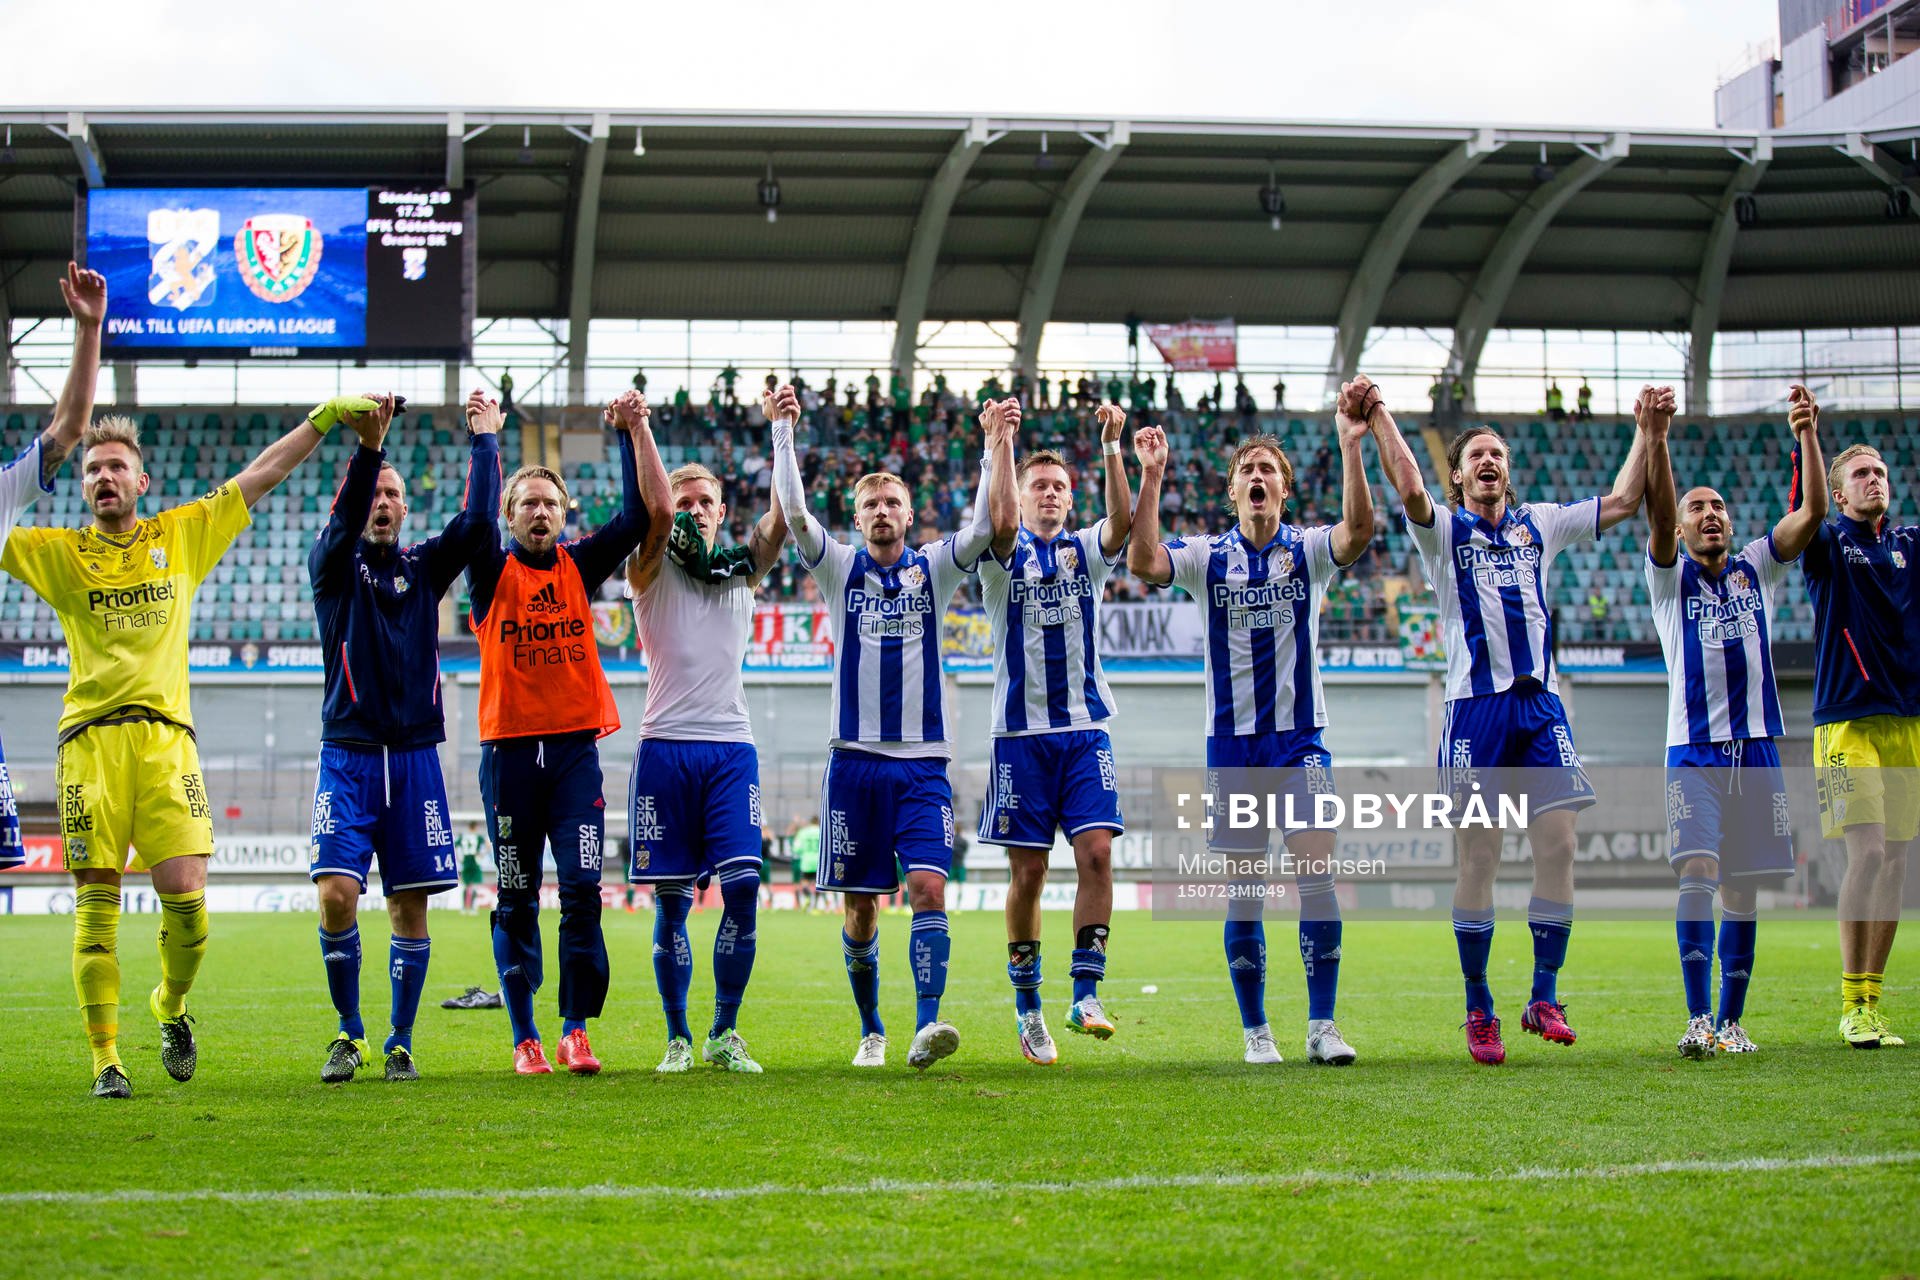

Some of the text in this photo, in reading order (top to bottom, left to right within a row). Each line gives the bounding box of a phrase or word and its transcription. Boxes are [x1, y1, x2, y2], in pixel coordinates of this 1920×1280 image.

[108, 318, 337, 335] KVAL TILL UEFA EUROPA LEAGUE
[1456, 544, 1540, 570] Prioritet
[1474, 566, 1536, 587] Finans
[88, 580, 175, 611] Prioritet
[1011, 574, 1092, 603] Prioritet
[1214, 578, 1306, 607] Prioritet
[1687, 589, 1762, 620] Prioritet
[104, 608, 169, 632] Finans
[1023, 603, 1083, 626] Finans
[1229, 607, 1294, 629] Finans
[857, 613, 925, 637] Finans
[1698, 617, 1759, 641] Finans
[23, 647, 69, 666] EM-K
[514, 643, 586, 669] Finans
[1453, 739, 1471, 754] SE
[1096, 750, 1113, 764] SE
[1303, 754, 1323, 768] SE
[1453, 754, 1472, 768] RN
[1830, 753, 1846, 767] SE
[998, 763, 1012, 779] SE
[1305, 767, 1327, 781] RN
[1453, 769, 1477, 784] EKE
[1830, 766, 1848, 781] RN
[181, 773, 200, 788] SE
[1307, 781, 1333, 795] EKE
[1832, 778, 1855, 797] EKE
[66, 784, 84, 800] SE
[185, 788, 206, 803] RN
[1668, 780, 1682, 798] SE
[316, 791, 332, 806] SE
[636, 796, 655, 811] SE
[997, 794, 1019, 809] EKE
[1772, 792, 1787, 807] SE
[66, 800, 85, 817] RN
[314, 805, 332, 820] RN
[423, 800, 438, 816] SE
[66, 815, 94, 833] EKE
[424, 815, 442, 831] RN
[636, 810, 657, 826] RN
[831, 810, 846, 826] SE
[312, 819, 337, 836] EKE
[578, 824, 598, 840] SE
[635, 825, 664, 841] EKE
[831, 825, 849, 841] RN
[3, 826, 22, 847] 11
[426, 830, 451, 847] EKE
[498, 845, 517, 861] SE
[579, 839, 599, 855] RN
[832, 840, 856, 856] EKE
[434, 853, 454, 872] 14
[498, 860, 521, 875] RN
[580, 854, 602, 871] EKE
[500, 874, 527, 890] EKE
[716, 916, 739, 955] SKF
[673, 932, 690, 967] SKF
[915, 939, 932, 984] SKF
